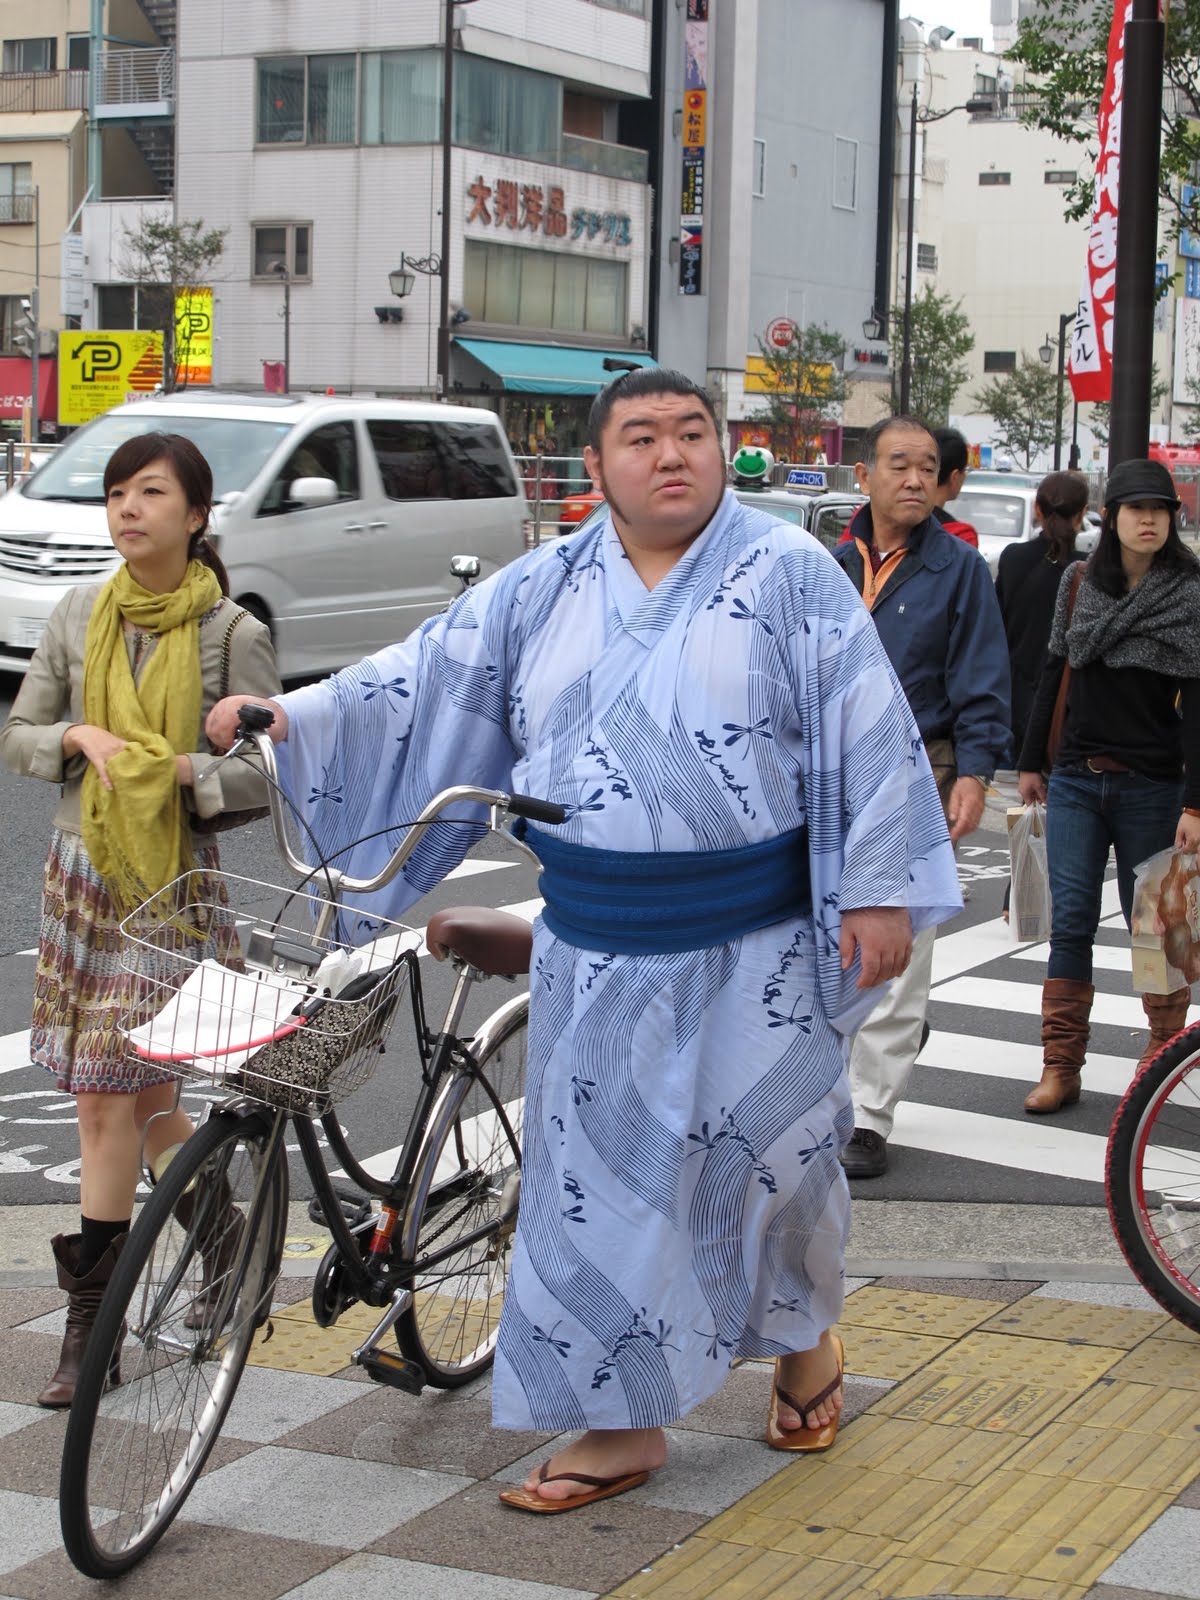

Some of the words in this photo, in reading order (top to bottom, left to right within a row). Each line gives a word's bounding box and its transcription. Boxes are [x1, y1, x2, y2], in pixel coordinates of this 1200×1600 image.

[687, 112, 701, 142] 松屋
[466, 175, 568, 237] 大判洋品
[789, 472, 822, 486] カードOK
